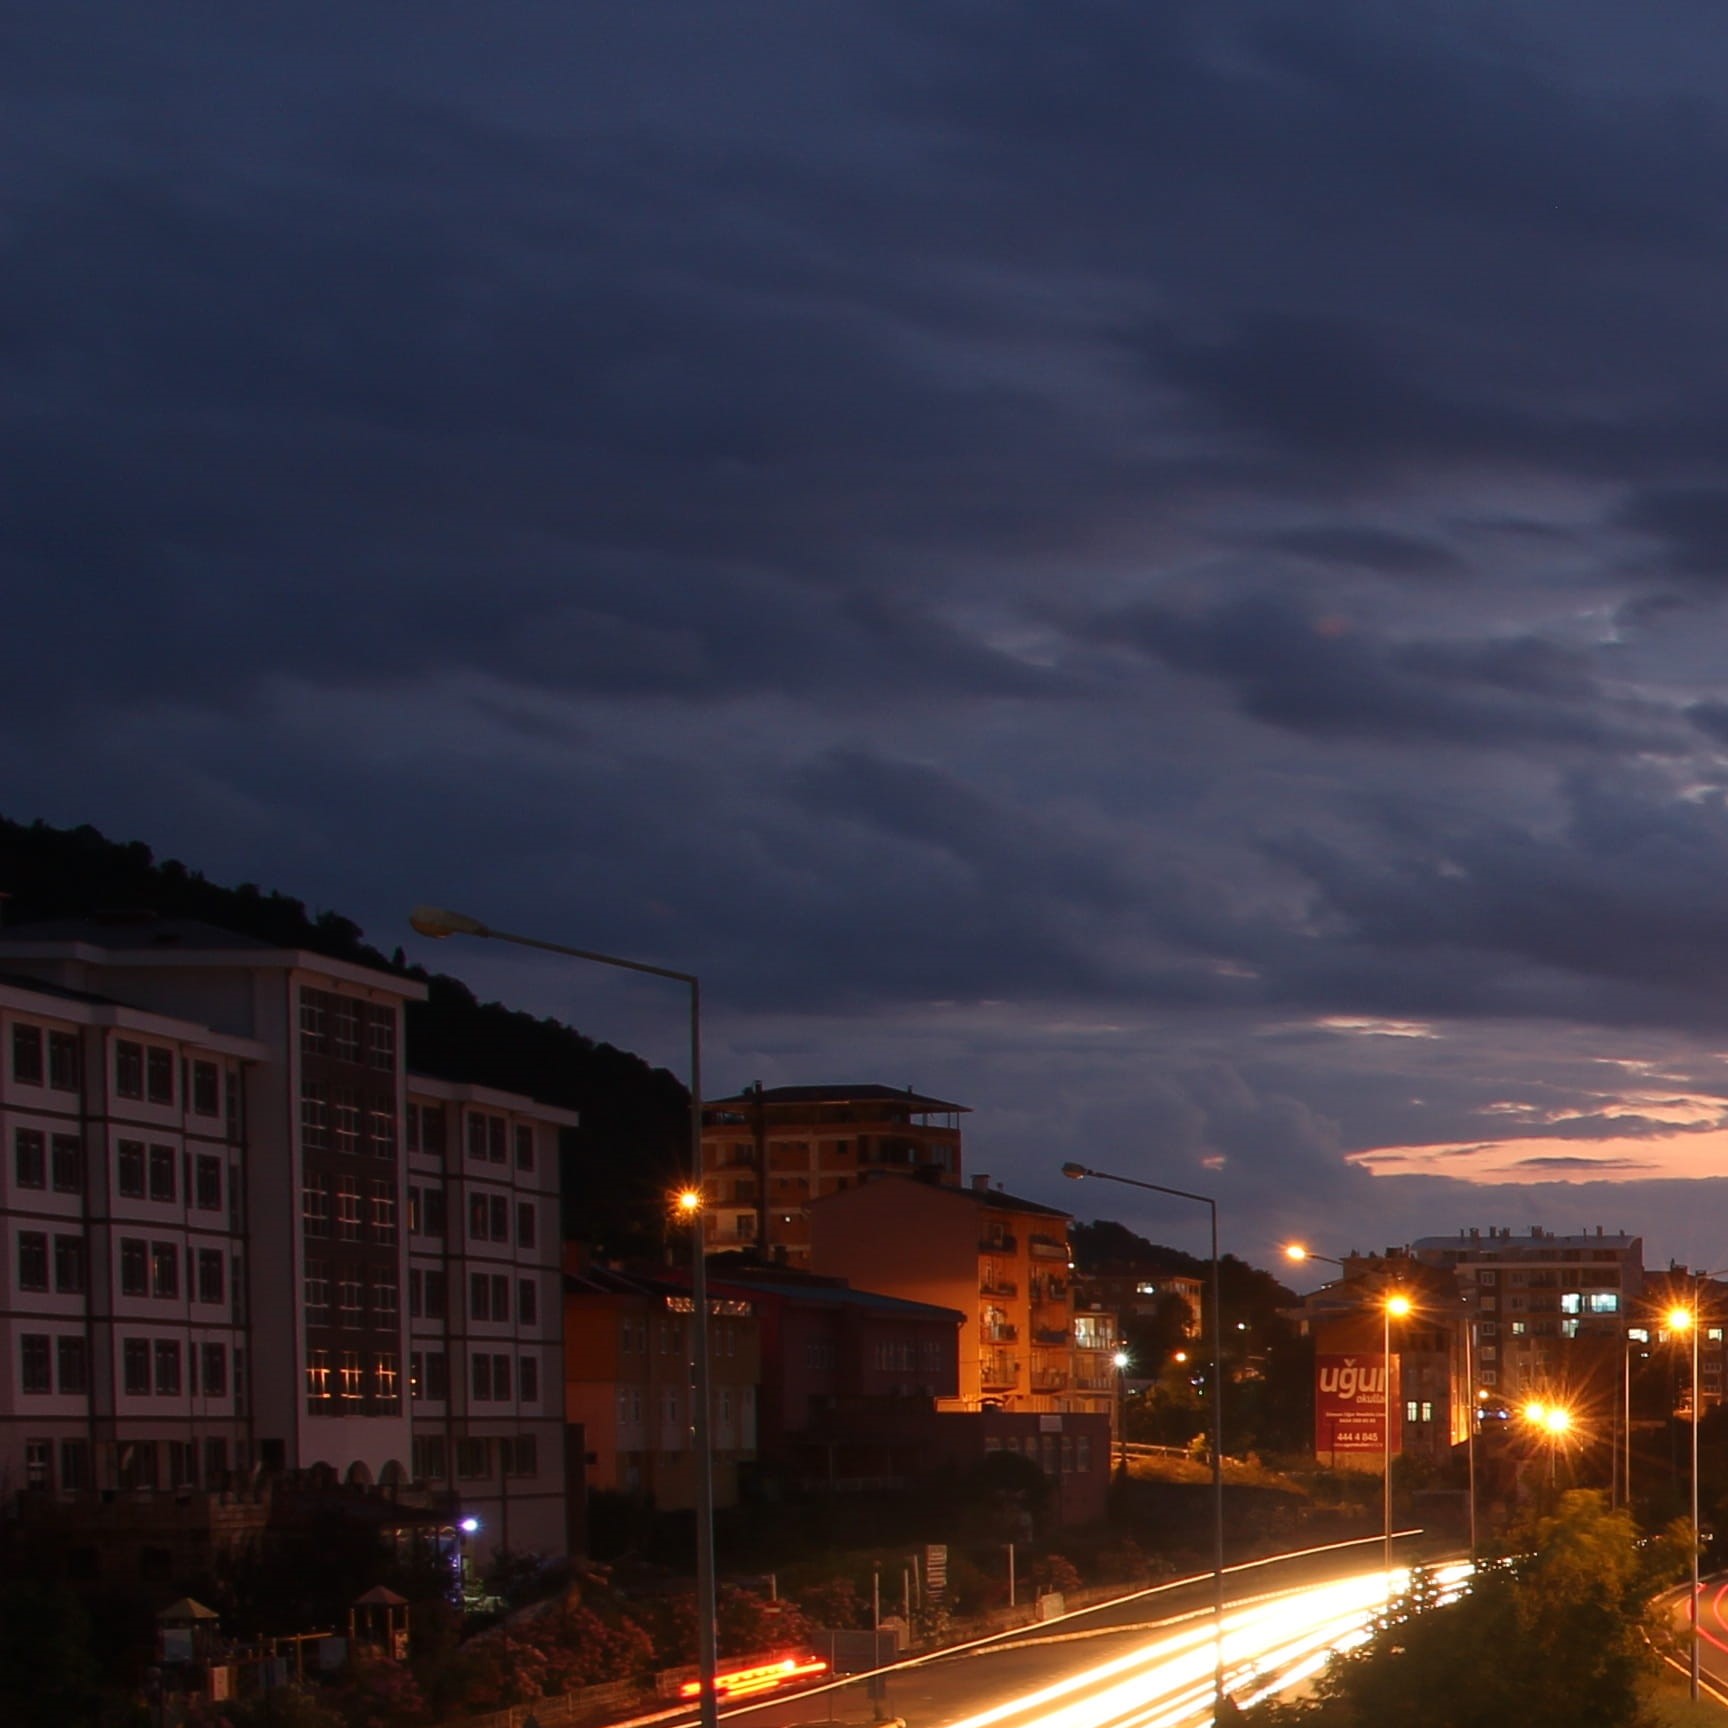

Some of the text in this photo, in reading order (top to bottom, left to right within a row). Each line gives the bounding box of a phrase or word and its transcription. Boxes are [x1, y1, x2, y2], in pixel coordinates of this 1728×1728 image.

[1319, 1358, 1393, 1400] uğur
[1356, 1393, 1391, 1404] okulla
[1336, 1432, 1353, 1441] 444
[1354, 1432, 1361, 1441] 4
